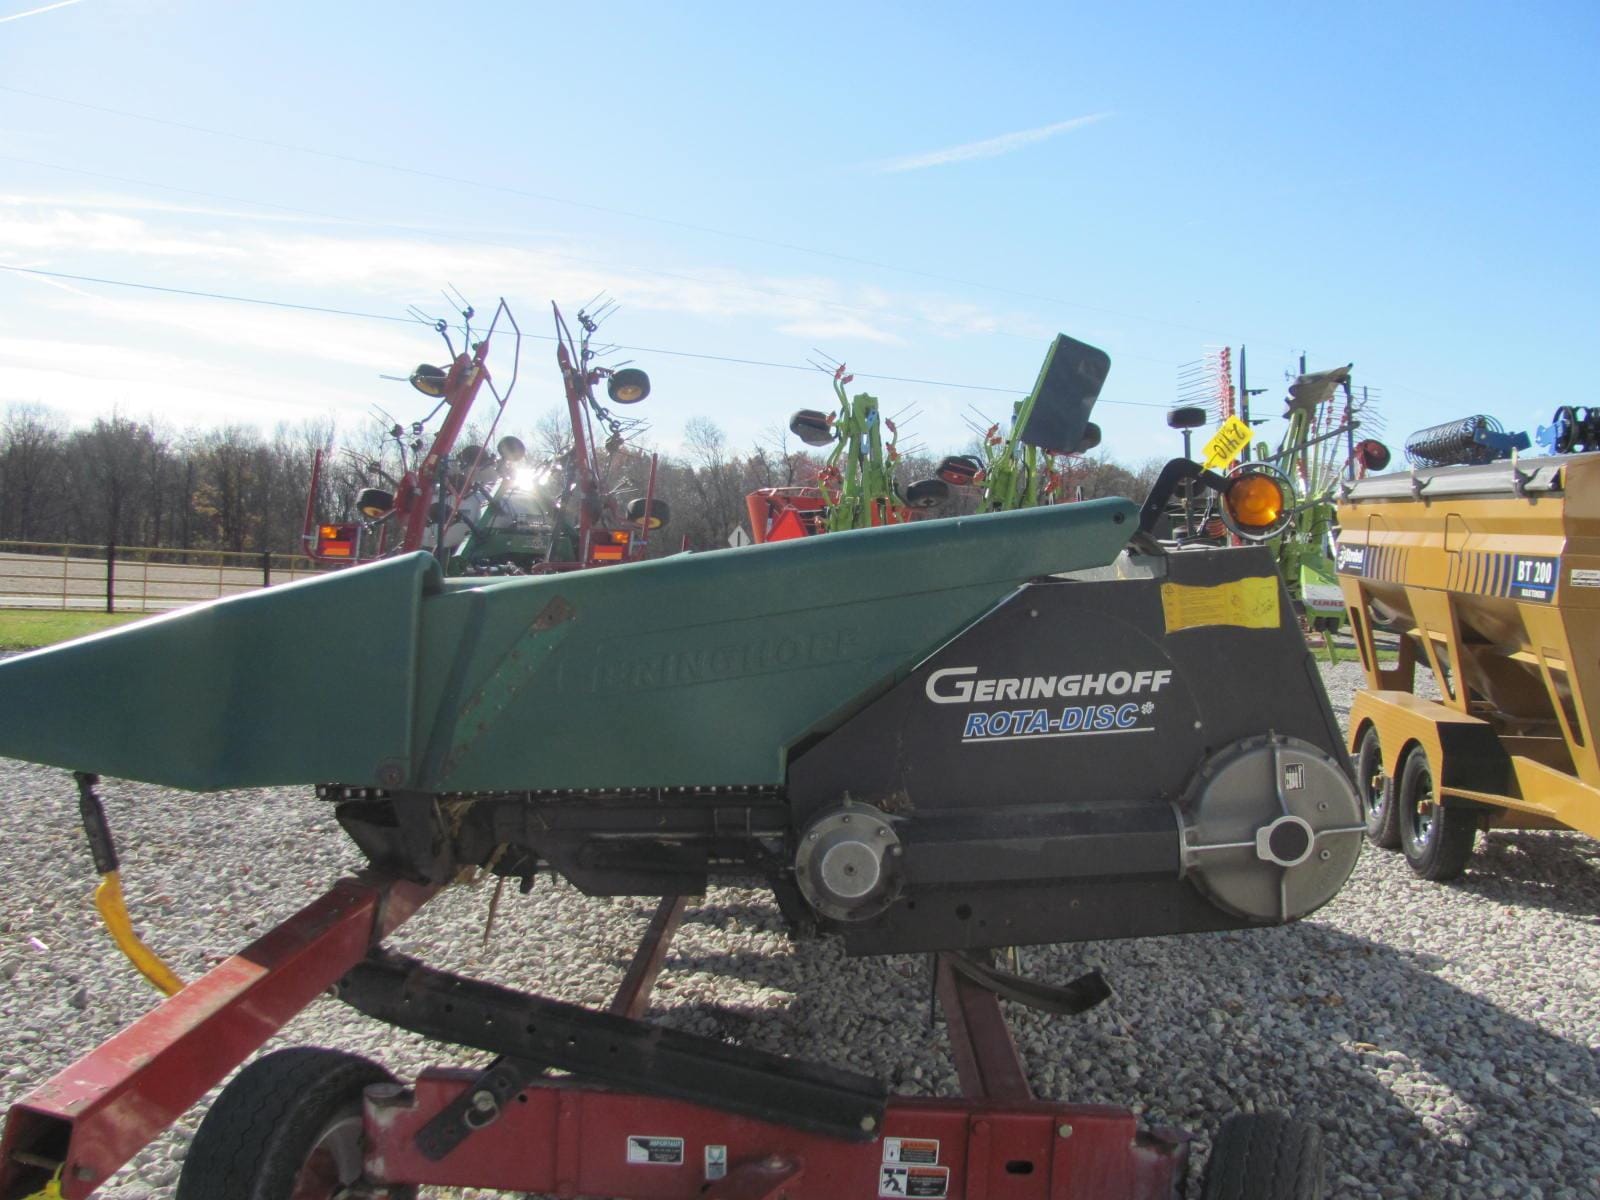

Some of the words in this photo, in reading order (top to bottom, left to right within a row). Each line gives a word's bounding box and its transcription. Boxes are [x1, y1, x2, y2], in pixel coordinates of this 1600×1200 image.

[1517, 560, 1533, 582] BT
[1533, 561, 1552, 584] 200
[925, 666, 1172, 704] GERINGHOFF
